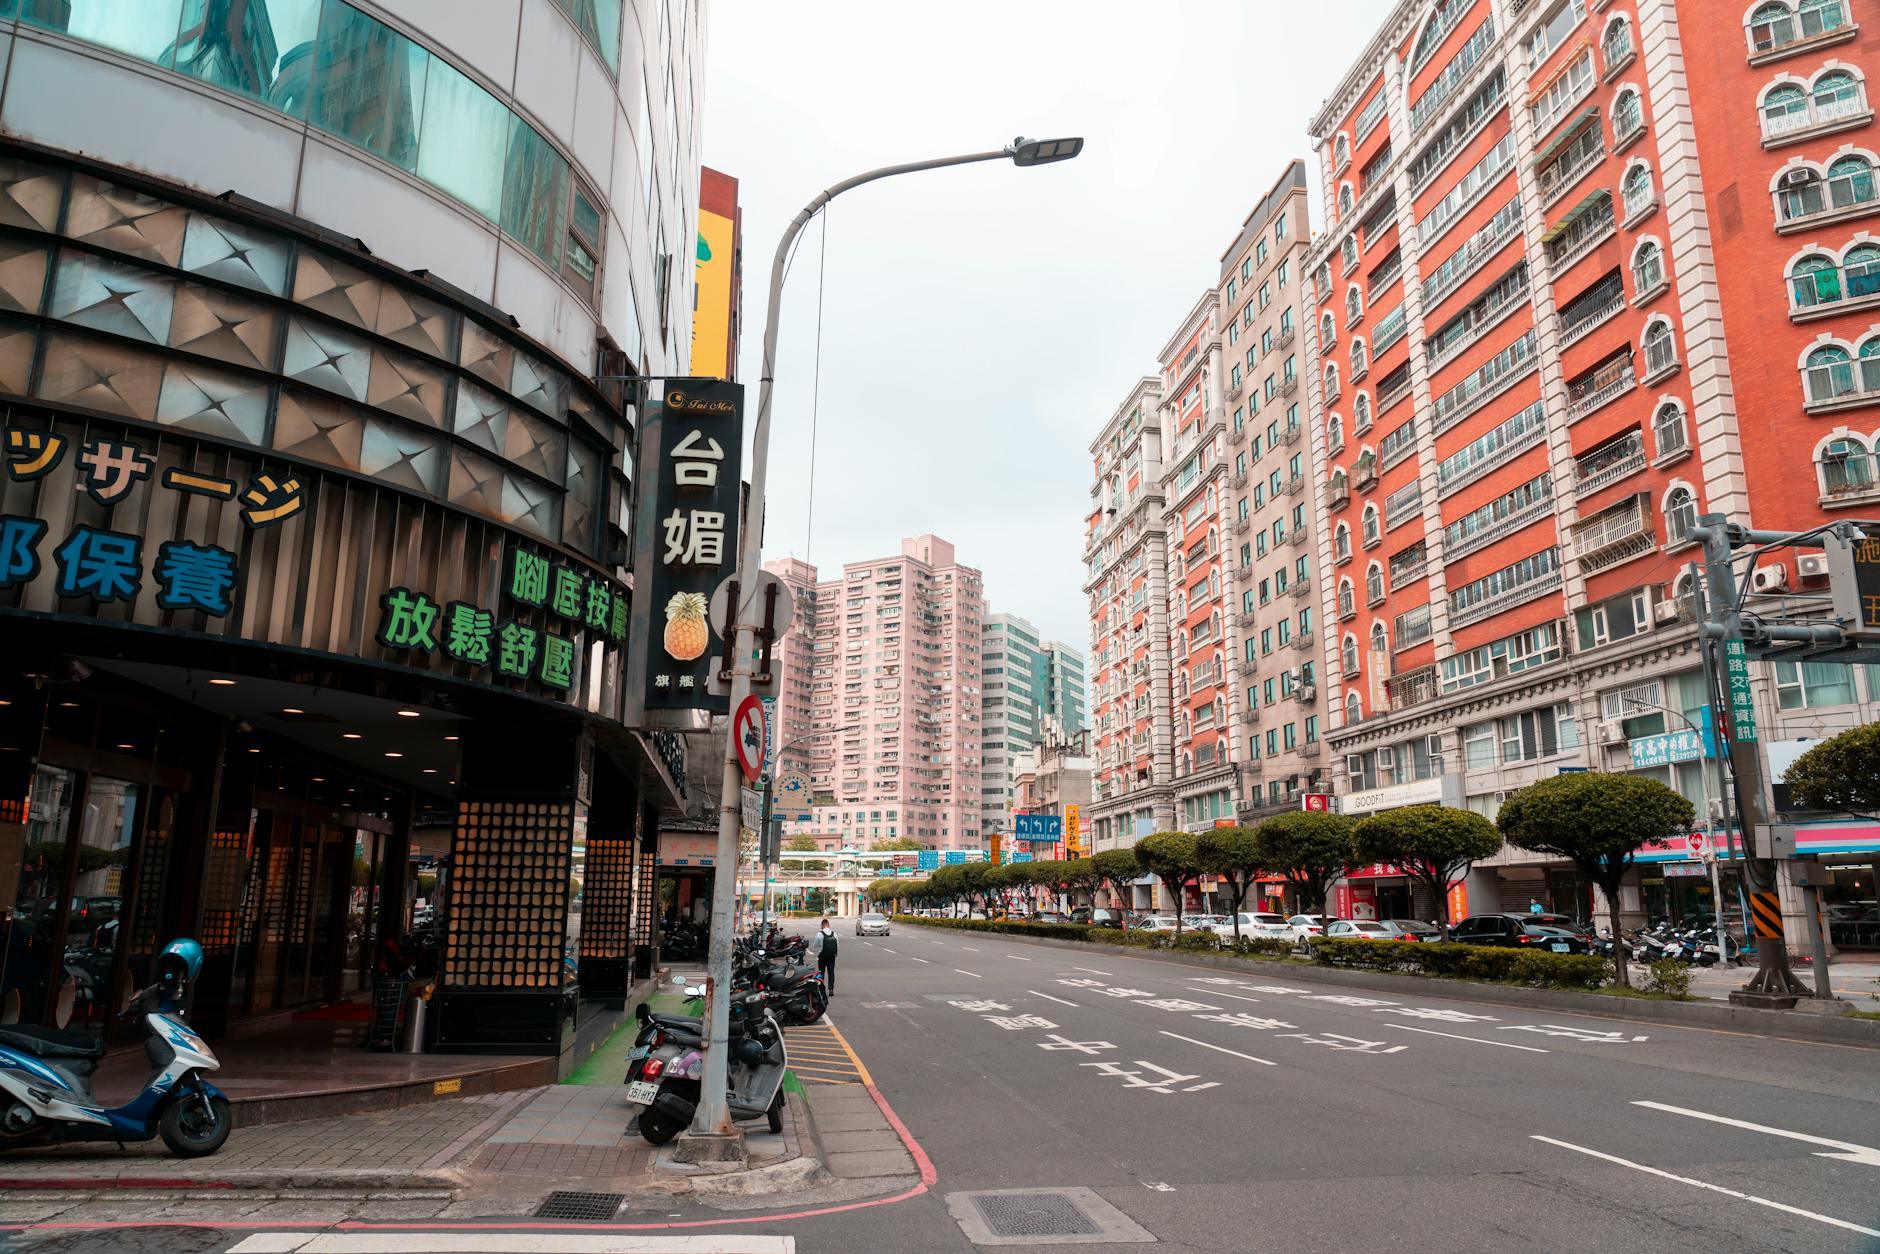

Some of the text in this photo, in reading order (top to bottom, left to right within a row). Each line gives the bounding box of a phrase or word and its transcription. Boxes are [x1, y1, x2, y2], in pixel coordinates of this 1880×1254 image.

[662, 429, 725, 566] 台媚
[385, 591, 575, 688] 放鬆舒壓
[654, 673, 709, 687] 旗艦
[1727, 642, 1752, 740] 道路交通資訊
